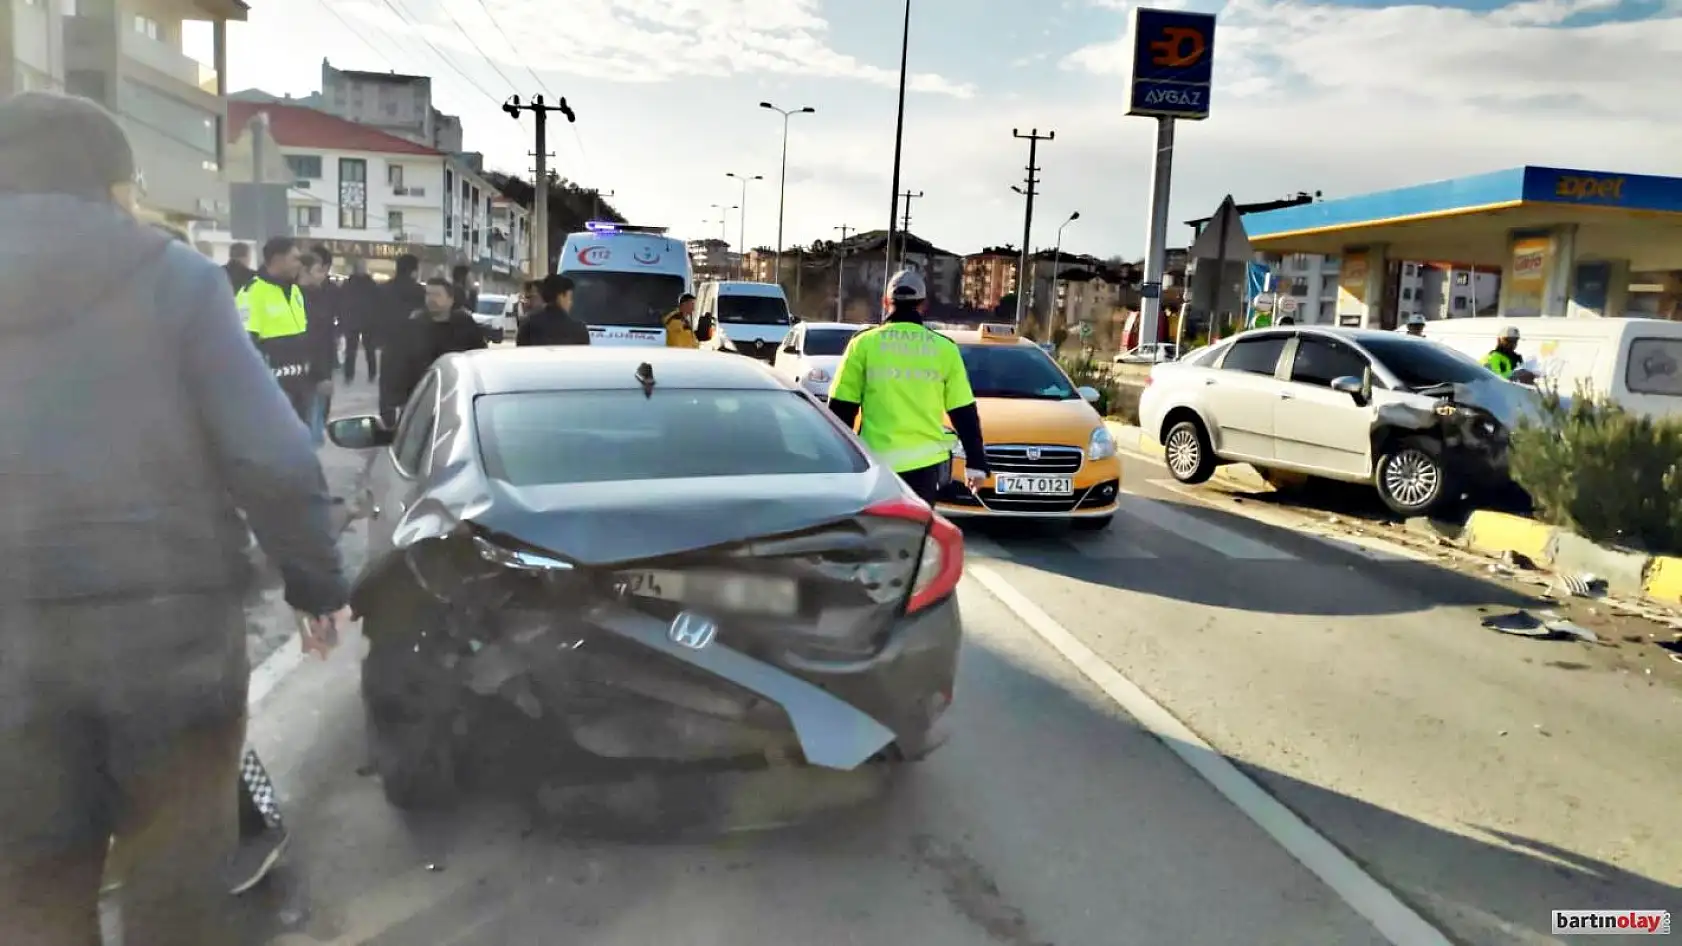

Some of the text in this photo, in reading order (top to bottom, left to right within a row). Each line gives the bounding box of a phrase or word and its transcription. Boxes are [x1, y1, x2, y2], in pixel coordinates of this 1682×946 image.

[1144, 88, 1202, 106] AYGAZ
[591, 250, 611, 260] 112
[1007, 478, 1069, 493] 74 T 0121
